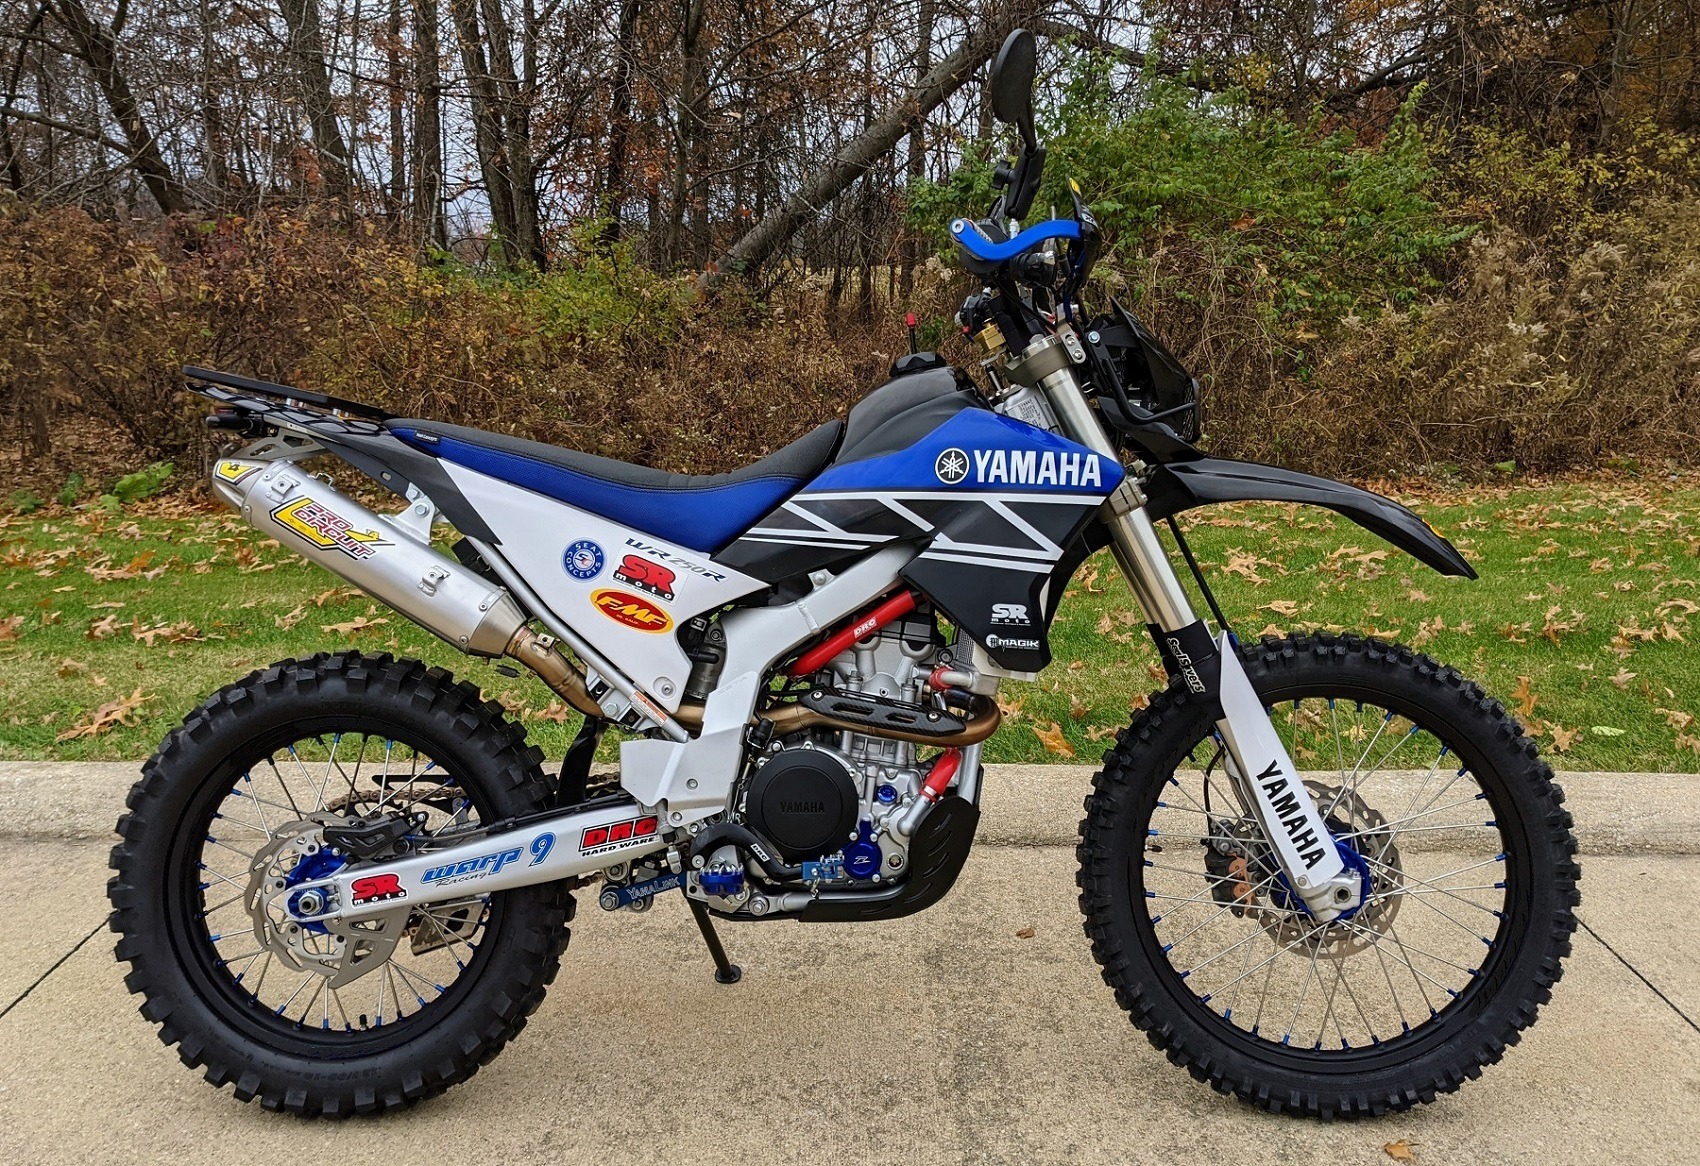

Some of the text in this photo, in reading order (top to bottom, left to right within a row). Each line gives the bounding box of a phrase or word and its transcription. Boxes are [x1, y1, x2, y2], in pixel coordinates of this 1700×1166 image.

[973, 449, 1102, 487] YAMAHA
[305, 503, 353, 532] PRO
[292, 509, 373, 557] CIRCUIT
[566, 542, 602, 578] SEAT CONCEPTS
[618, 553, 676, 594] SR
[615, 572, 673, 600] moto
[596, 595, 669, 625] FMF
[991, 603, 1029, 620] SR
[853, 616, 877, 638] DRC
[998, 638, 1041, 650] MAGIK
[1166, 637, 1207, 694] SealSvers
[779, 801, 826, 814] YAMAHA
[1256, 759, 1326, 870] YAMAHA
[582, 815, 659, 848] DRC
[420, 832, 557, 885] warp 9
[750, 843, 770, 862] DRC
[351, 873, 405, 901] SR
[434, 872, 488, 888] Racing
[354, 892, 406, 905] moto
